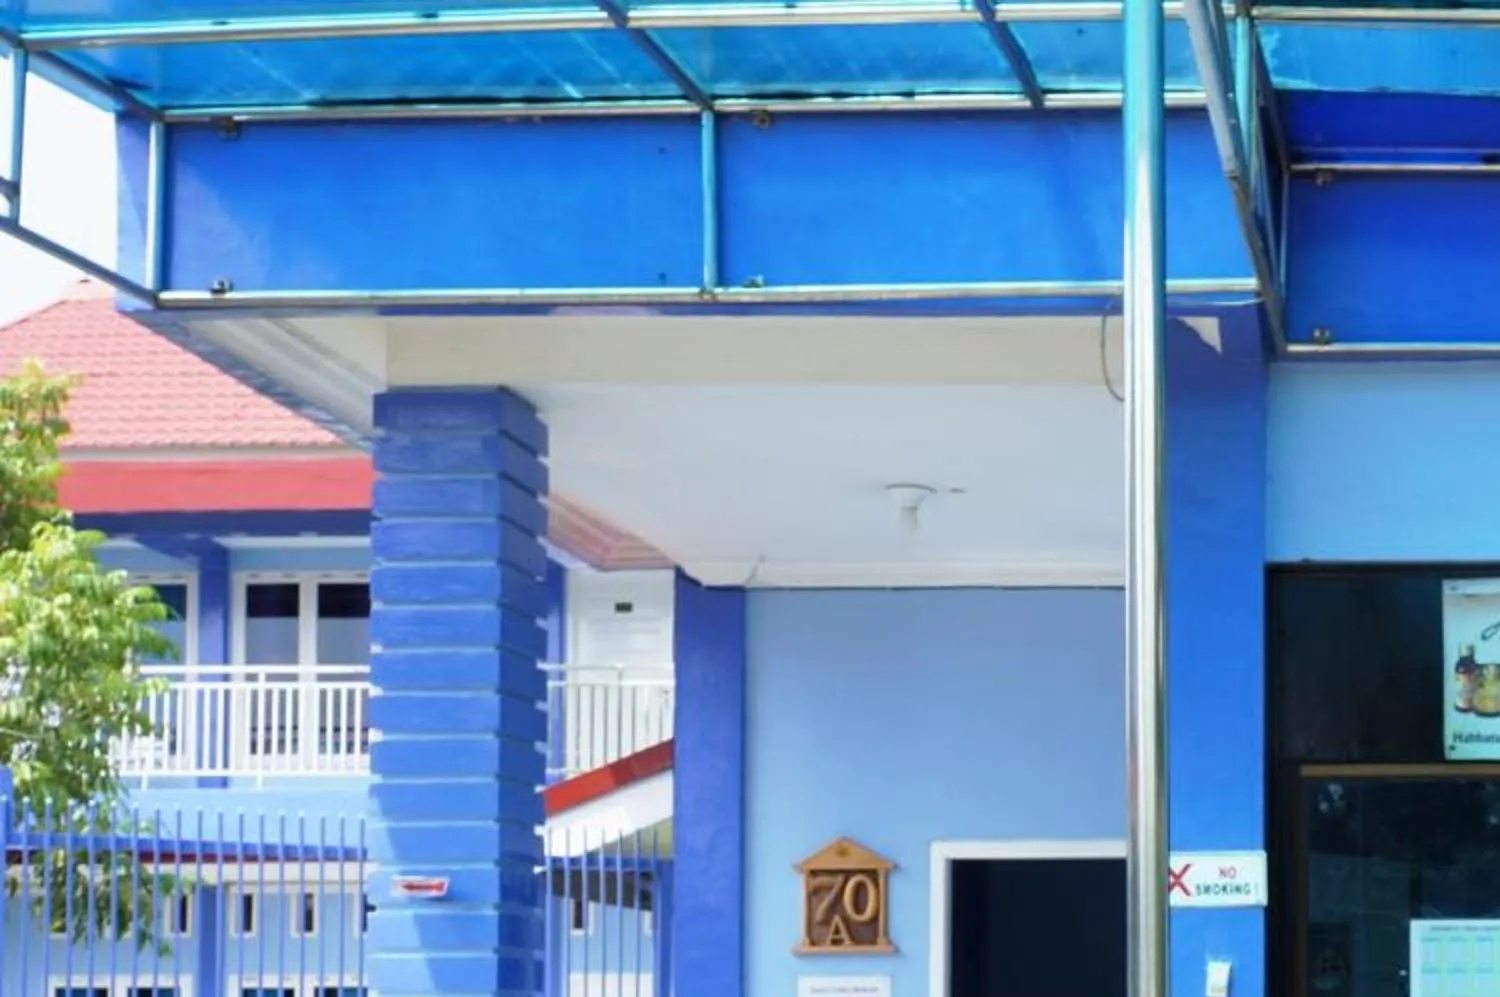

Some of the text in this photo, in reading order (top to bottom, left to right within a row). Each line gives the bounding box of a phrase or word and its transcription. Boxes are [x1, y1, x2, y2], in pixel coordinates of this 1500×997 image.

[1218, 866, 1237, 878] NO
[810, 873, 878, 923] 70
[1195, 884, 1252, 895] SMOKING
[826, 914, 853, 945] A
